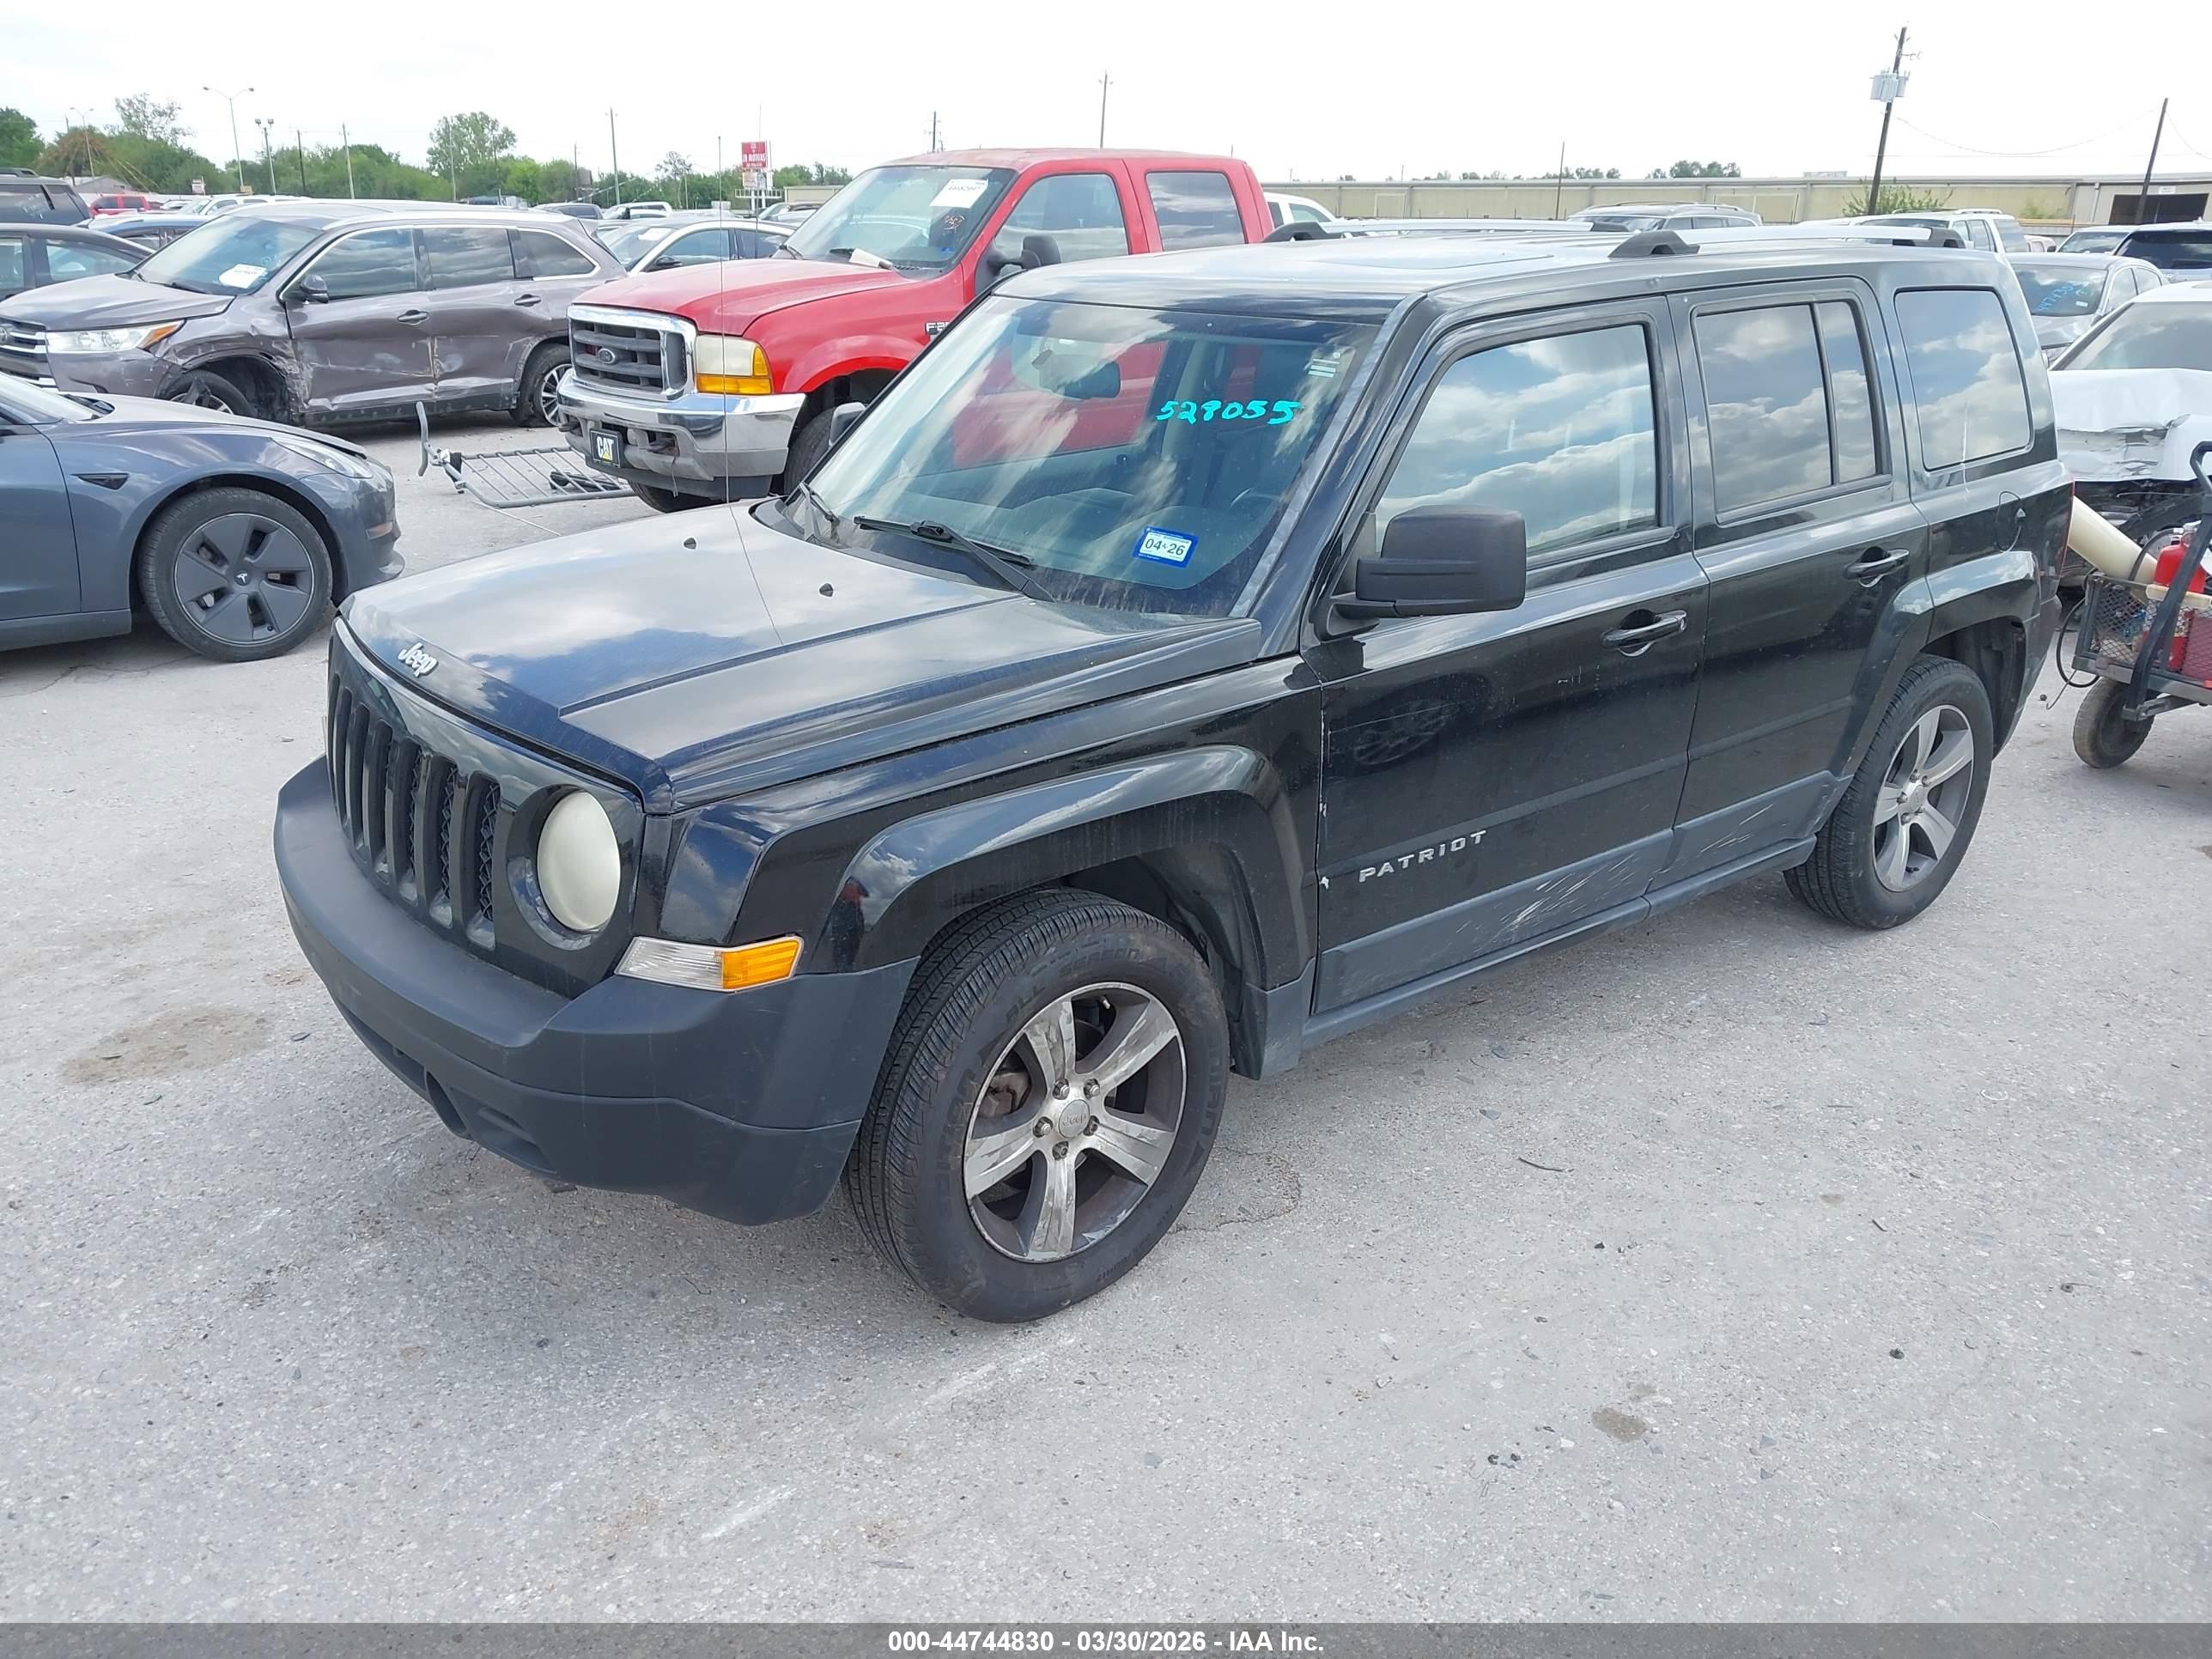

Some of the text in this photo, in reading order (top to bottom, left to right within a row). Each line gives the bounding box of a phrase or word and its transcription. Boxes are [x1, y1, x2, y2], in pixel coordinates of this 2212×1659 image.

[597, 436, 614, 461] CAT
[1145, 538, 1163, 550] 04
[1167, 543, 1186, 556] 26
[398, 641, 438, 678] Jeep
[1358, 830, 1487, 883] PATRIOT
